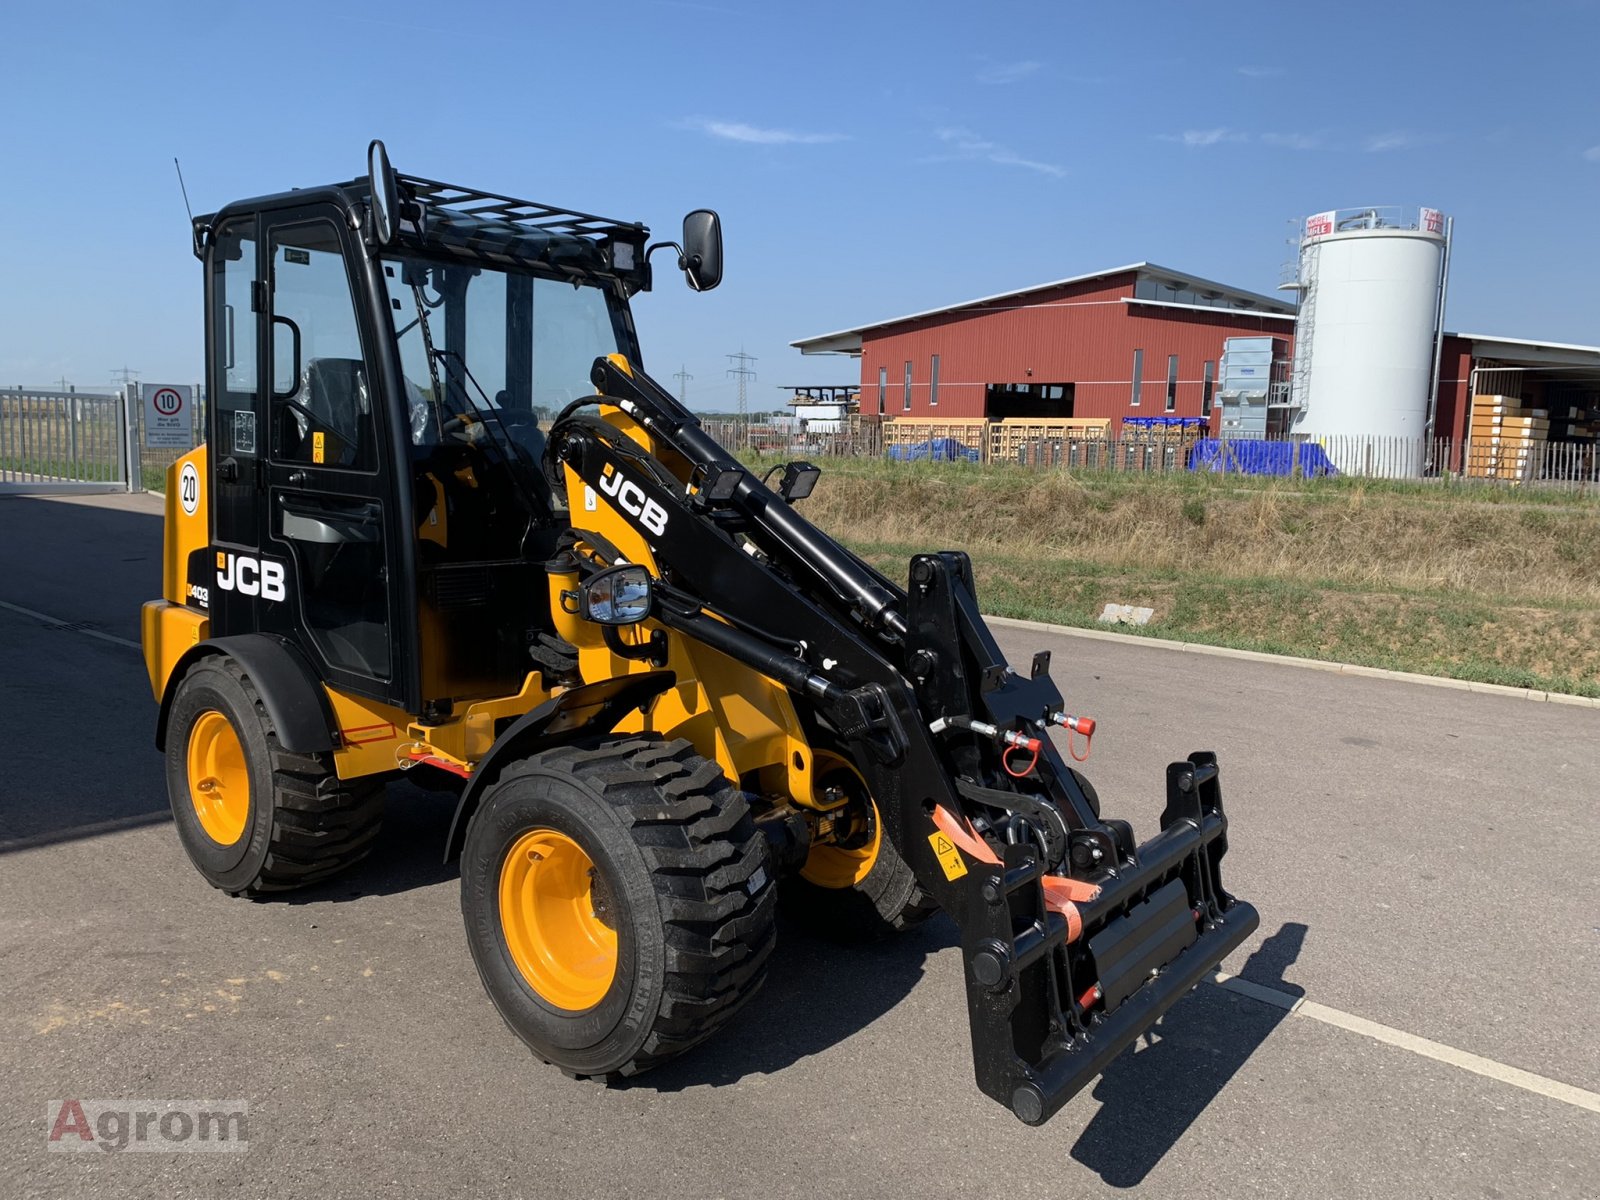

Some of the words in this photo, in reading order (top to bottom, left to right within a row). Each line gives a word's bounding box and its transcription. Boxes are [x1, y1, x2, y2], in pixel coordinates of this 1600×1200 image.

[161, 394, 174, 409] 10
[183, 475, 196, 503] 20
[599, 462, 668, 537] JCB
[217, 551, 286, 602] JCB
